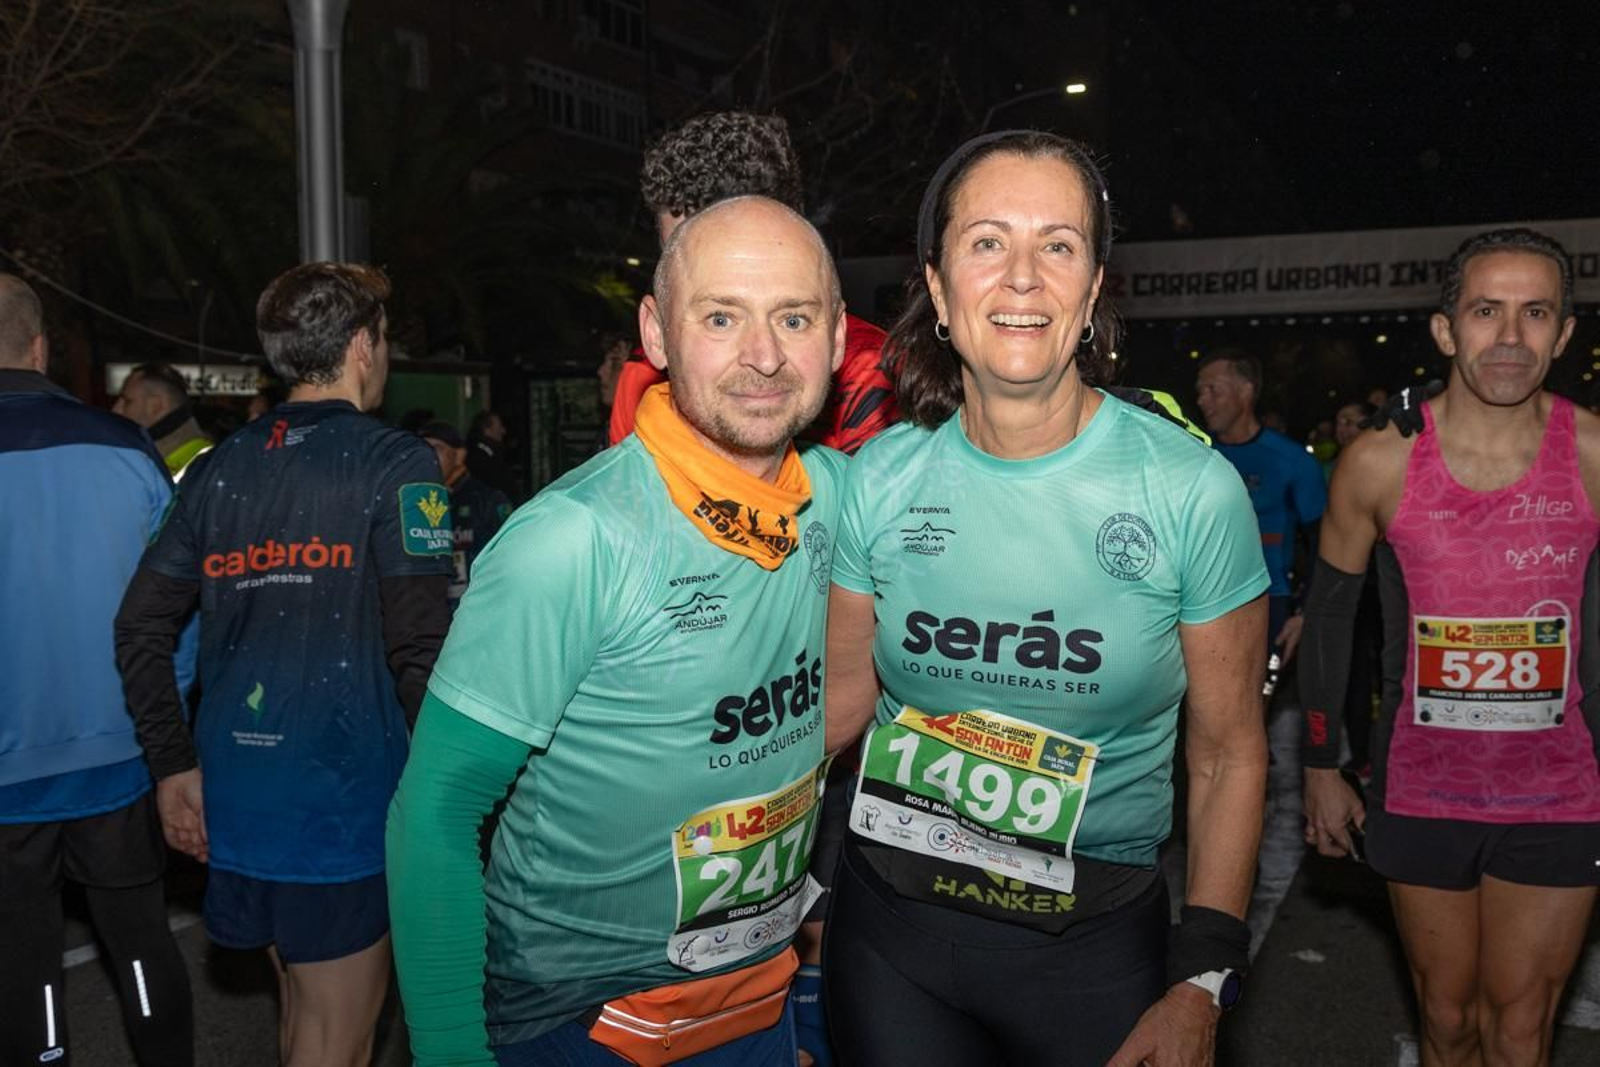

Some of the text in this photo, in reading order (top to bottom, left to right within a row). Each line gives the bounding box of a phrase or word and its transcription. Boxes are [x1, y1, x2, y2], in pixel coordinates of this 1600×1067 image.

[1131, 269, 1258, 297] CARRERA
[1265, 261, 1381, 292] URBANA
[202, 536, 353, 578] calderón
[901, 609, 1105, 675] serás
[1444, 625, 1473, 643] 42
[902, 659, 1101, 695] LO QUE QUIERAS SER
[1440, 650, 1541, 690] 528
[709, 648, 822, 745] serás
[709, 723, 813, 769] LO QUE QUIERAS
[955, 726, 1033, 760] SAN ANTON
[888, 732, 1062, 834] 1499
[905, 794, 930, 809] ROSA
[726, 805, 766, 841] 42
[727, 904, 758, 920] SERGIO
[932, 874, 1077, 914] HANKER
